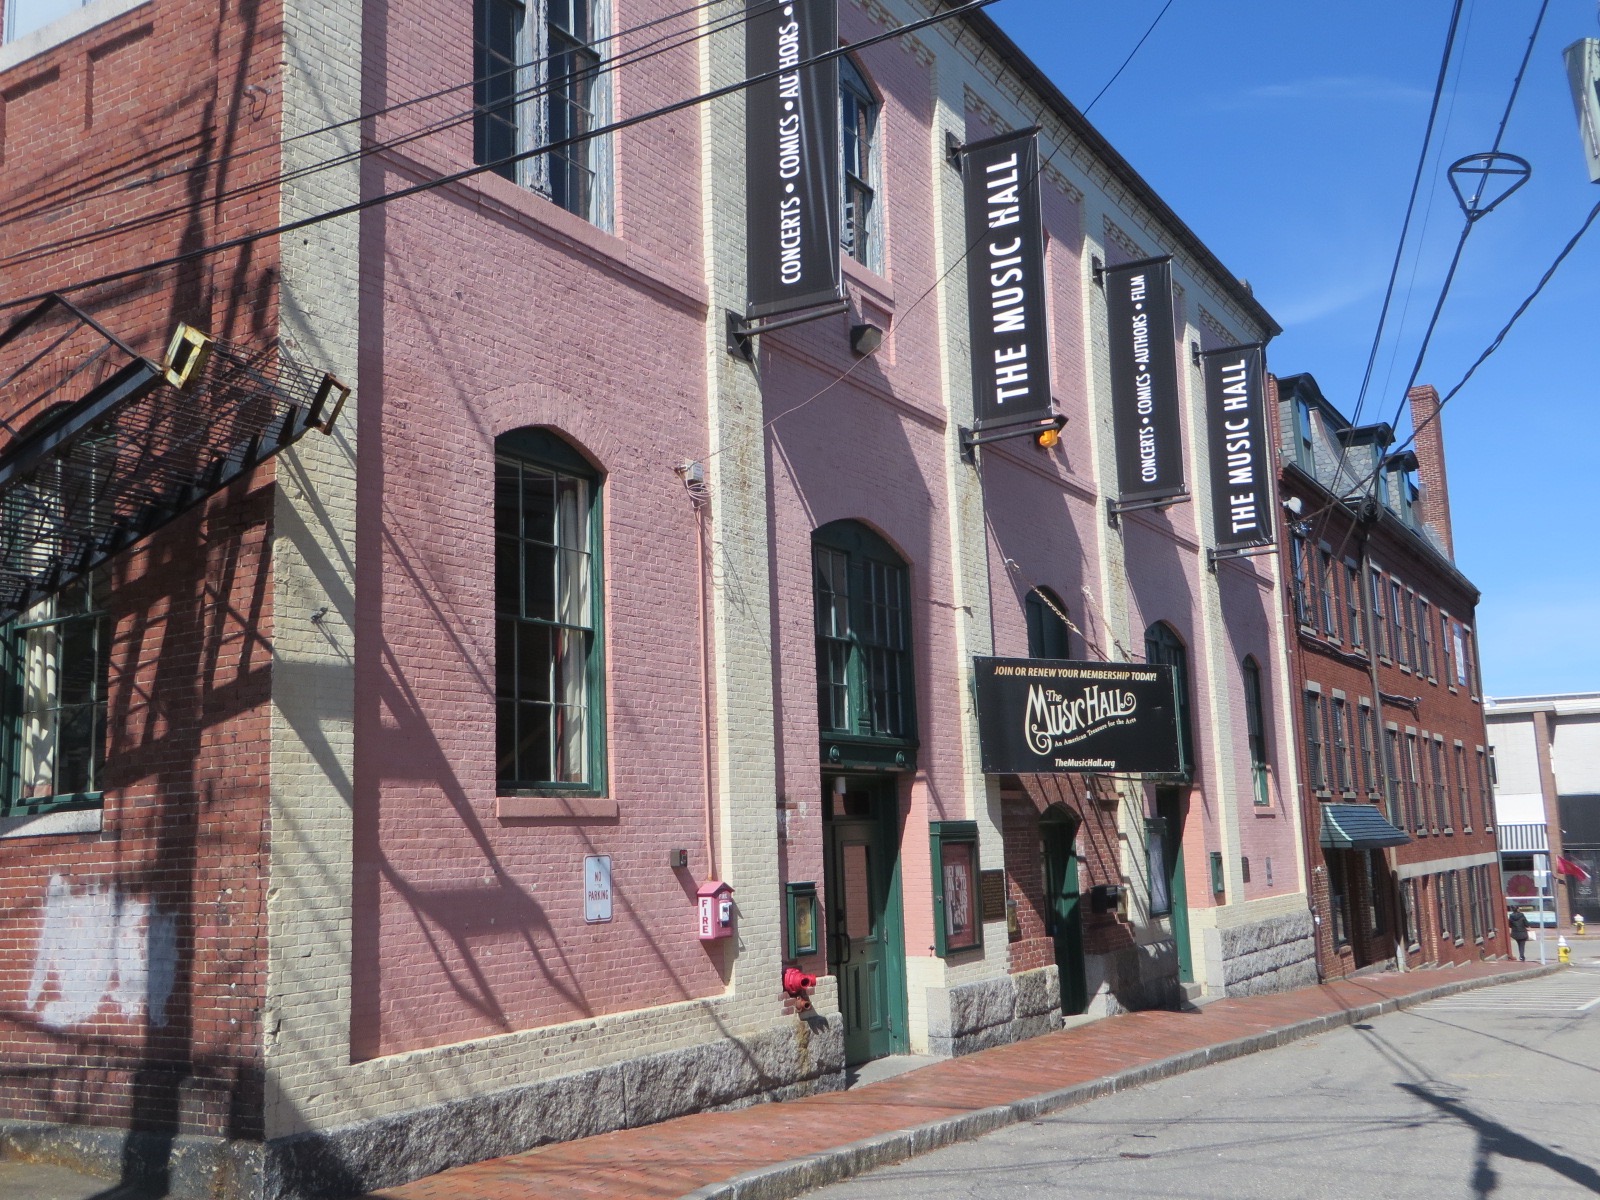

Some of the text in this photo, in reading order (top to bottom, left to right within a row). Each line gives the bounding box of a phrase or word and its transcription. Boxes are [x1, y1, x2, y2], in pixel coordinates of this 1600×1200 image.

[779, 113, 800, 179] COMICS
[780, 196, 802, 285] CONCERTS
[986, 152, 1029, 404] THE MUSIC HALL
[1130, 274, 1157, 482] CONCERTS COMICS AUTHORS FILM
[1221, 358, 1257, 534] THE MUSIC HALL
[994, 666, 1157, 682] JOIN OR RENEW YOUR MEMBERSHIP TODAY!
[1046, 689, 1063, 703] The
[1054, 758, 1116, 769] TheMusicHall.org
[588, 889, 609, 901] PARKING
